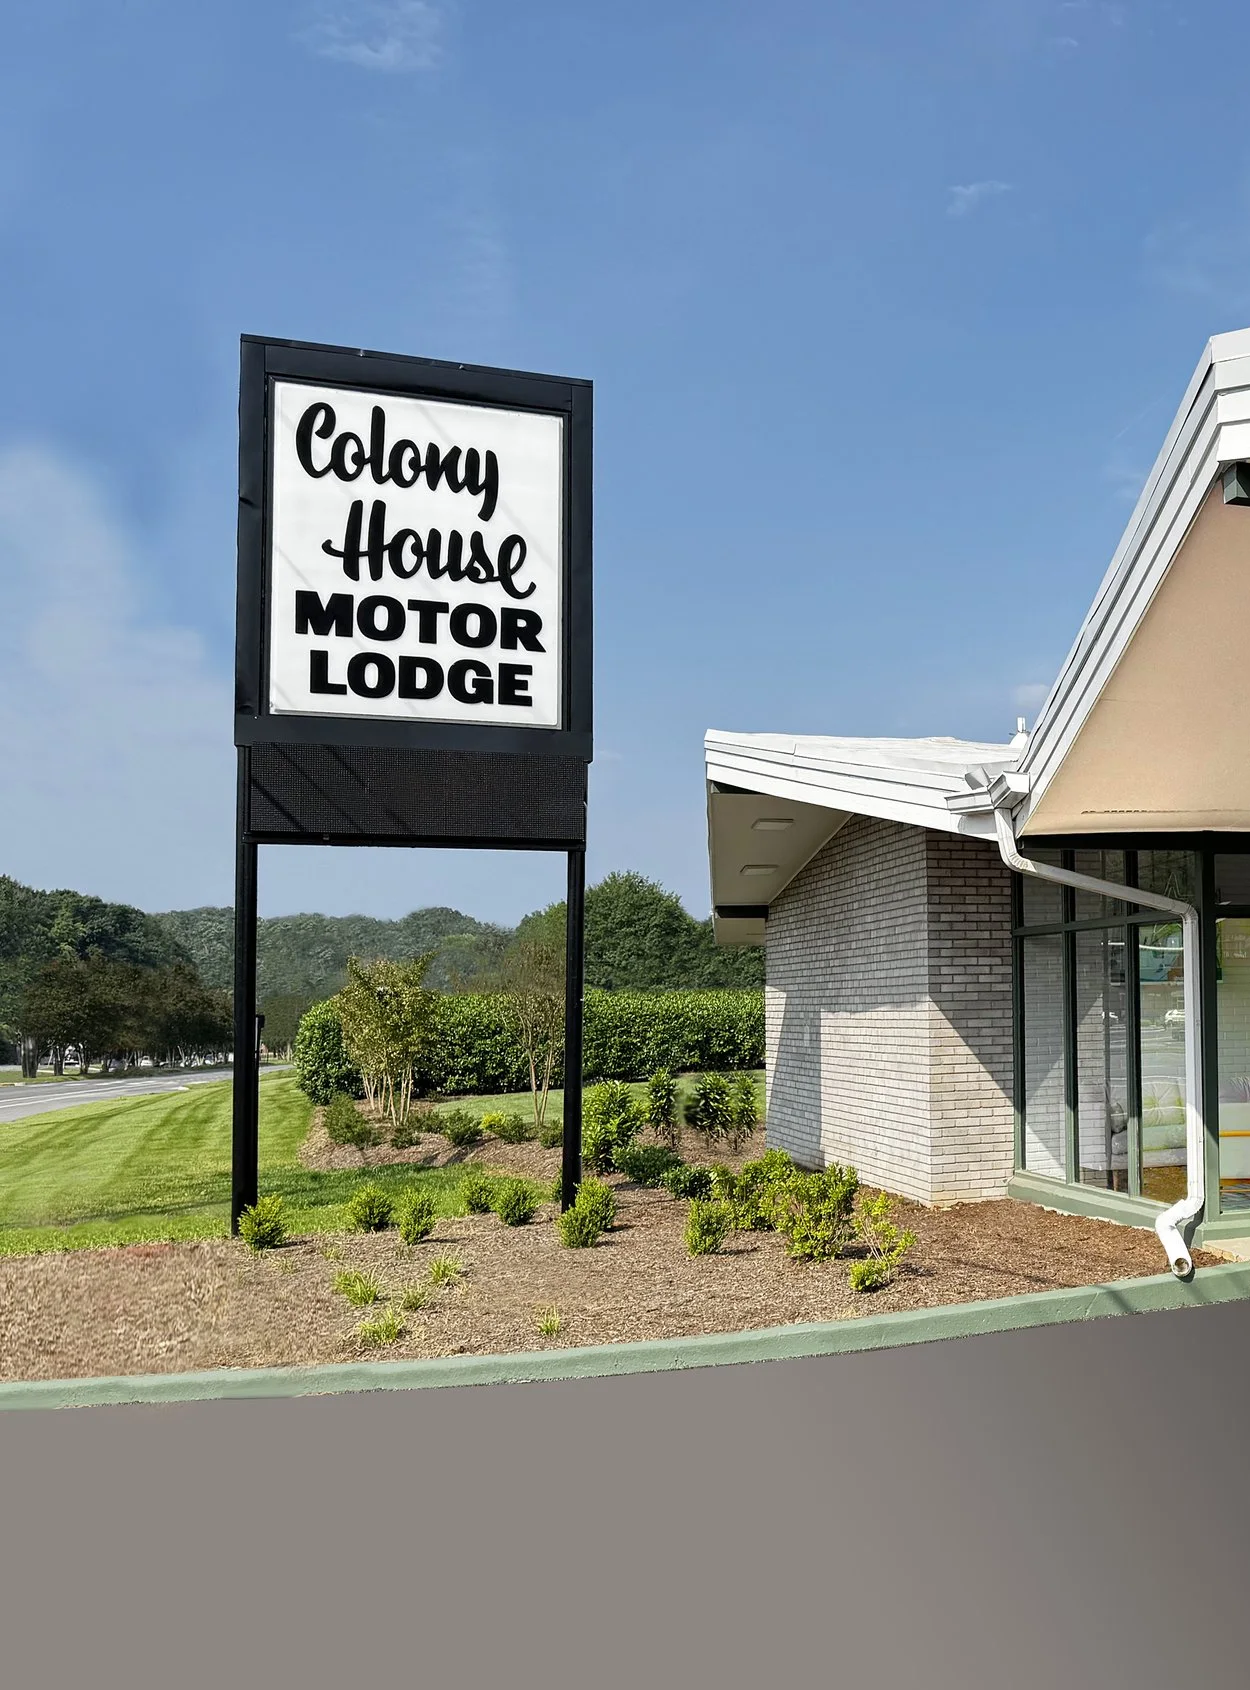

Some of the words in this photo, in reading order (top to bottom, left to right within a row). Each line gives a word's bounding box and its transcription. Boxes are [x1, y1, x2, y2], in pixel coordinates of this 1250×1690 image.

[296, 401, 499, 521] Colony
[322, 499, 537, 600] House
[295, 590, 547, 653] MOTOR
[309, 650, 533, 707] LODGE
